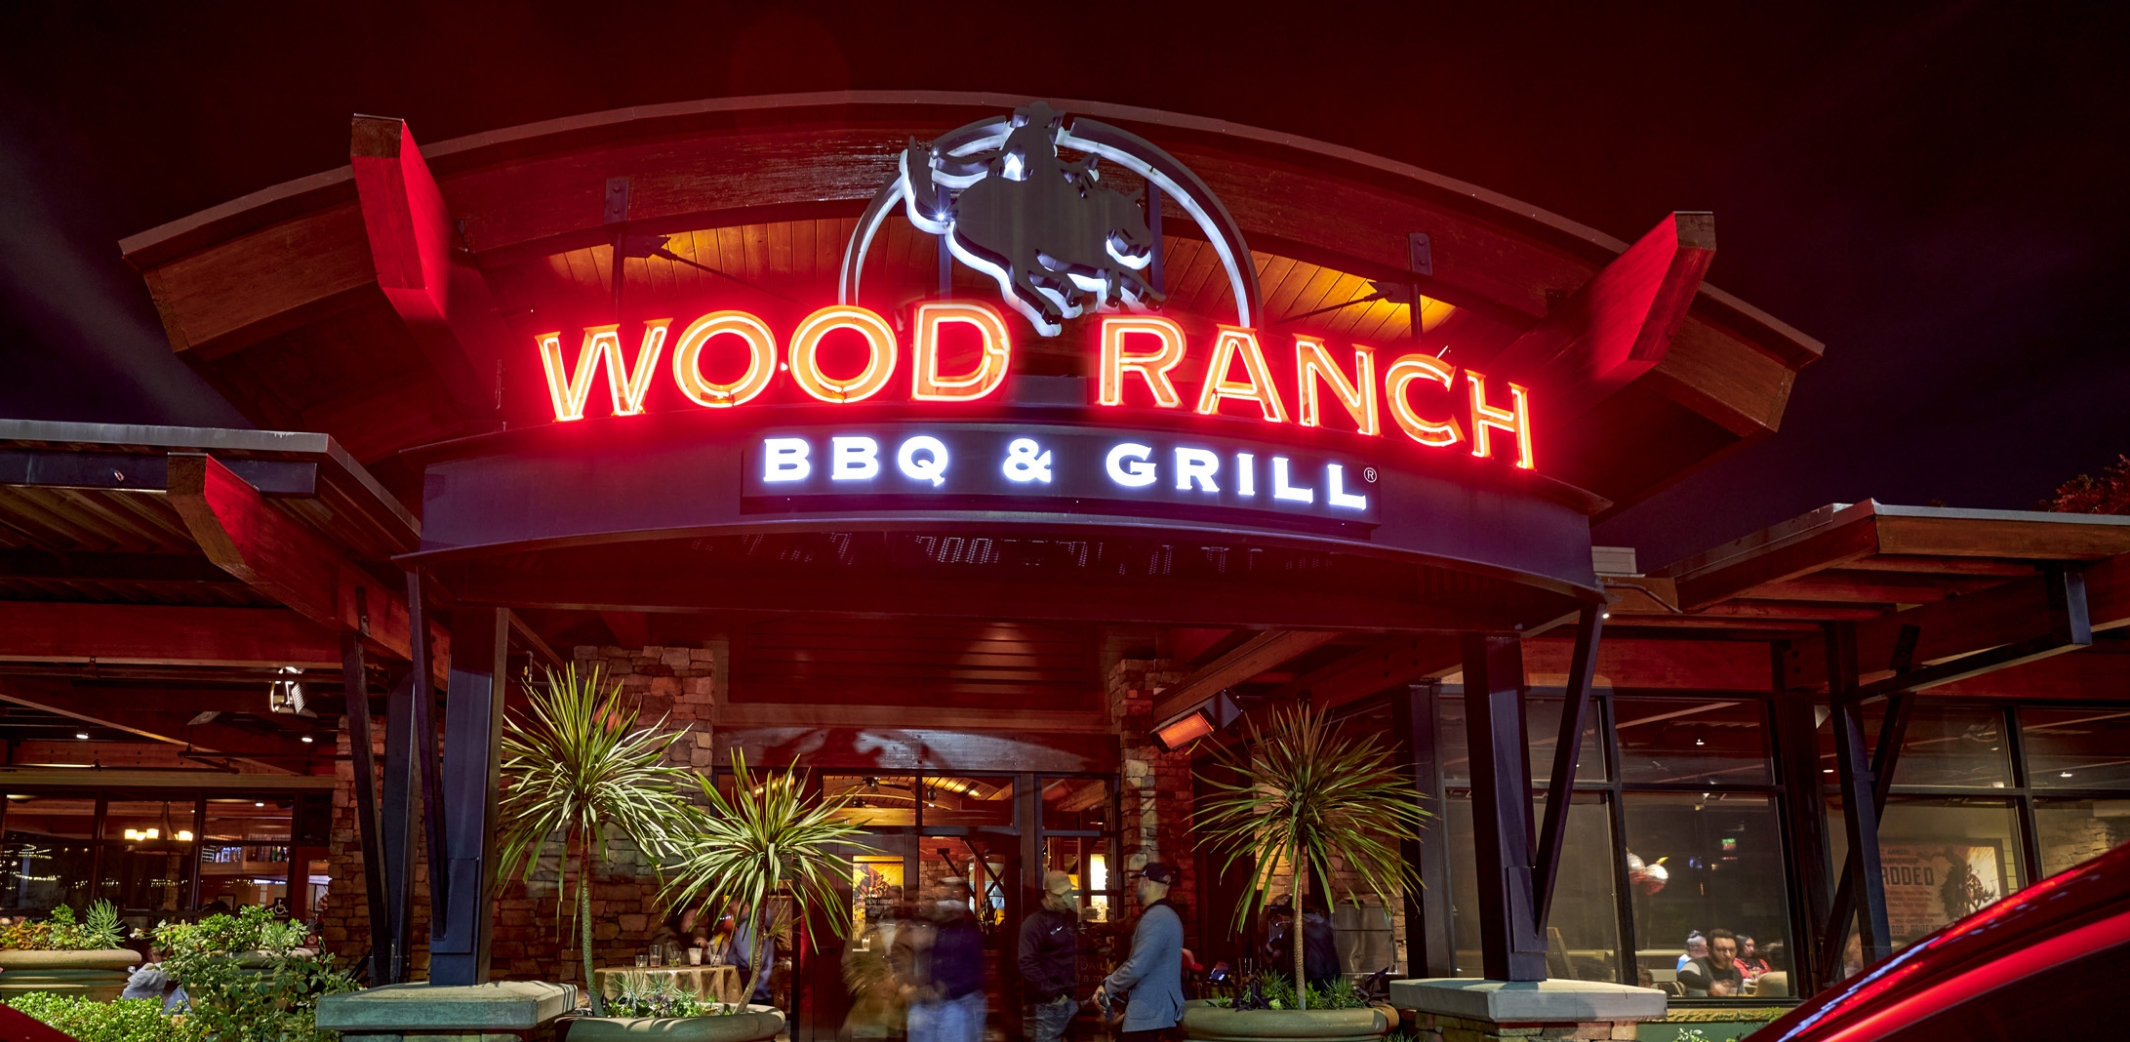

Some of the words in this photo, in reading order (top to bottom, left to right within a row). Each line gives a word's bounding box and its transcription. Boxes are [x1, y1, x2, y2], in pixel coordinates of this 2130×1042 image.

[535, 300, 1012, 422] WOOD
[1096, 315, 1535, 470] RANCH
[762, 435, 950, 487] BBQ
[1002, 437, 1052, 484] &
[1881, 866, 1935, 886] RODEO
